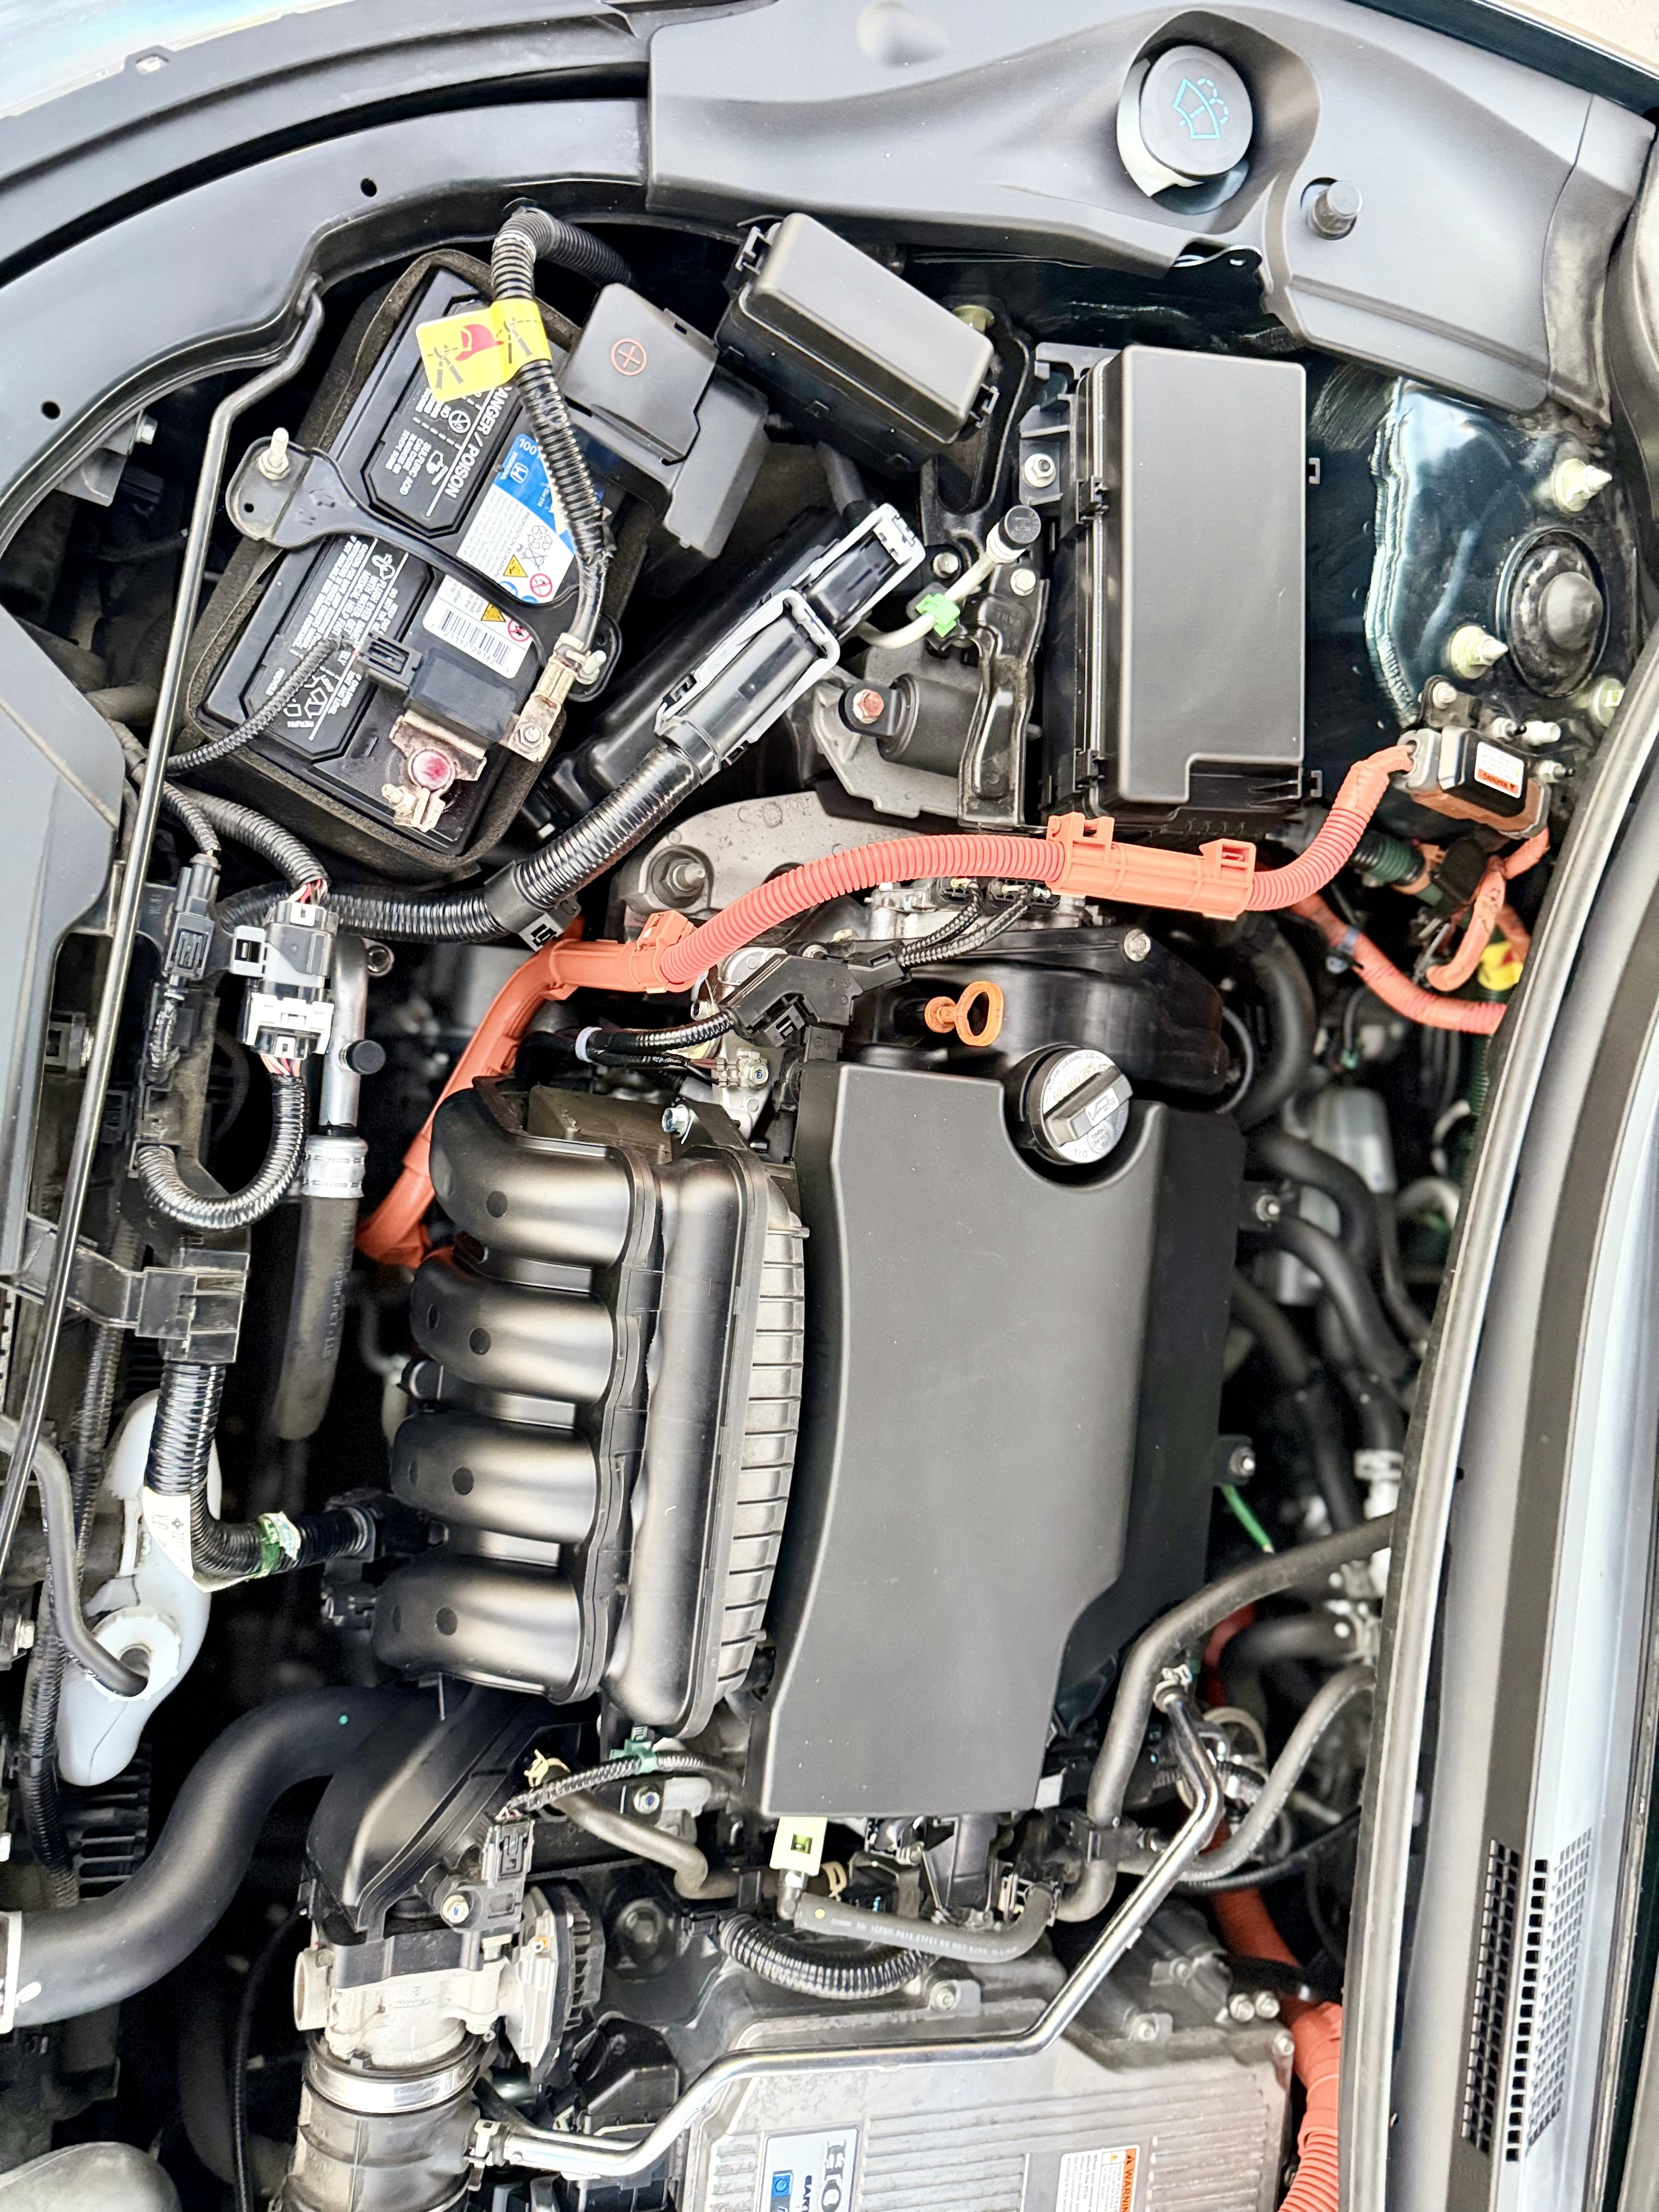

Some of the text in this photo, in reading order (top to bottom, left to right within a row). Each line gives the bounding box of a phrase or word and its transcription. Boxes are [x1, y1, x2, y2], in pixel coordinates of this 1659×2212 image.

[439, 405, 451, 419] NO
[477, 384, 510, 436] ANGER
[392, 433, 417, 475] BLINDNESS OR
[399, 442, 432, 495] SULFURIC ACID
[402, 437, 424, 471] CAN CAUSE
[499, 450, 518, 481] HONDA
[444, 442, 480, 499] POISON
[349, 534, 357, 543] IF
[509, 511, 530, 547] PROPOSITION
[342, 540, 353, 555] NOT
[338, 578, 350, 595] SAFE
[345, 566, 356, 580] FOR
[349, 569, 371, 601] MEDICAL
[342, 574, 379, 635] WITH WATER. GET
[369, 578, 387, 603] FLUSH
[388, 587, 398, 599] DO
[317, 606, 335, 635] STARTING
[340, 599, 355, 619] HELP
[360, 601, 375, 622] EYES
[386, 602, 399, 619] KEEP
[264, 666, 285, 697] RECYCLE
[336, 684, 348, 698] AND
[340, 678, 359, 708] CHILDREN
[1046, 1052, 1094, 1093] SEE OWNER'S MANUAL
[1073, 1148, 1087, 1158] OIL
